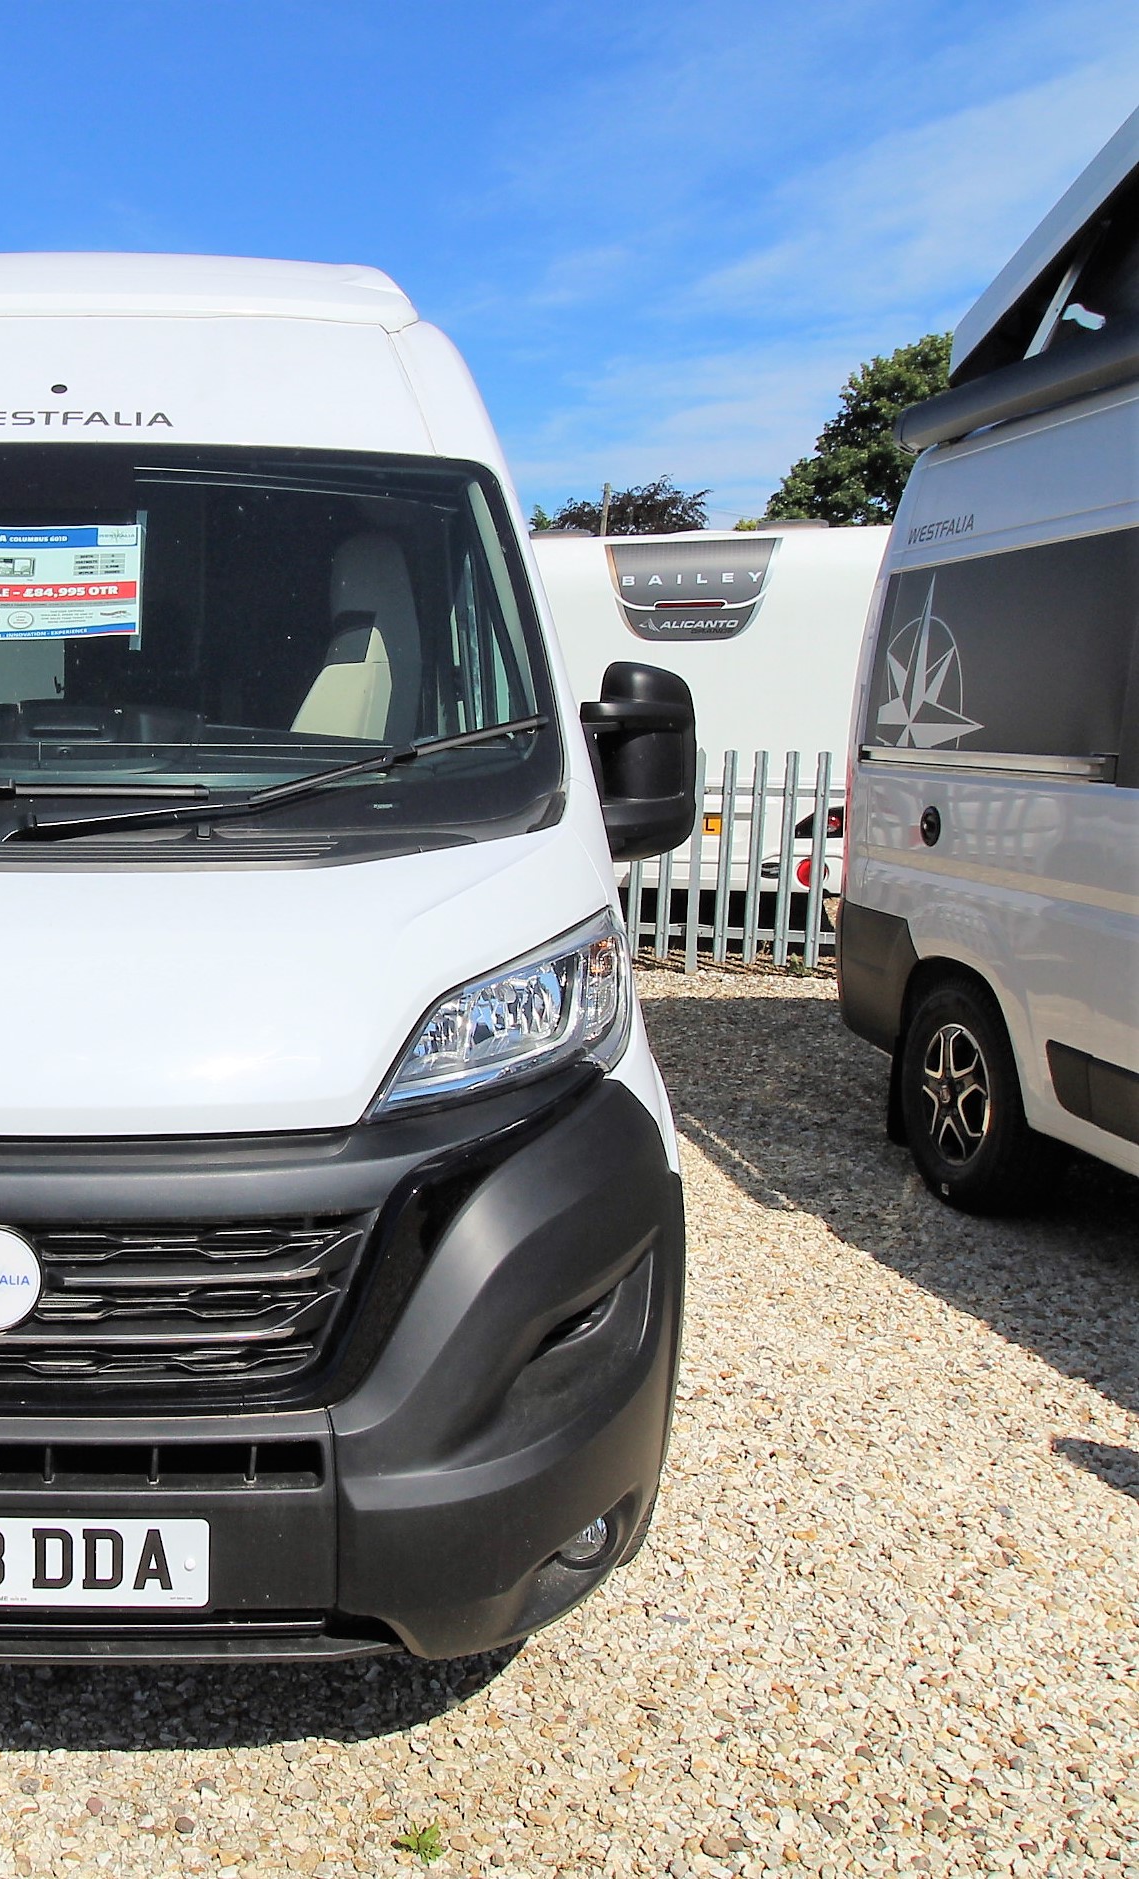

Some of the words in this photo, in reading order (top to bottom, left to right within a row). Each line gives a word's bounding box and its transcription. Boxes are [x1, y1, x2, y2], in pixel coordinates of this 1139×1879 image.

[907, 513, 975, 545] WESTFALIA
[621, 571, 762, 587] BAILEY
[23, 586, 86, 598] £84,995
[88, 585, 119, 596] OTR
[660, 619, 739, 629] ALICANTO
[51, 628, 88, 636] EXPERIENCE
[31, 1528, 174, 1590] DDA
